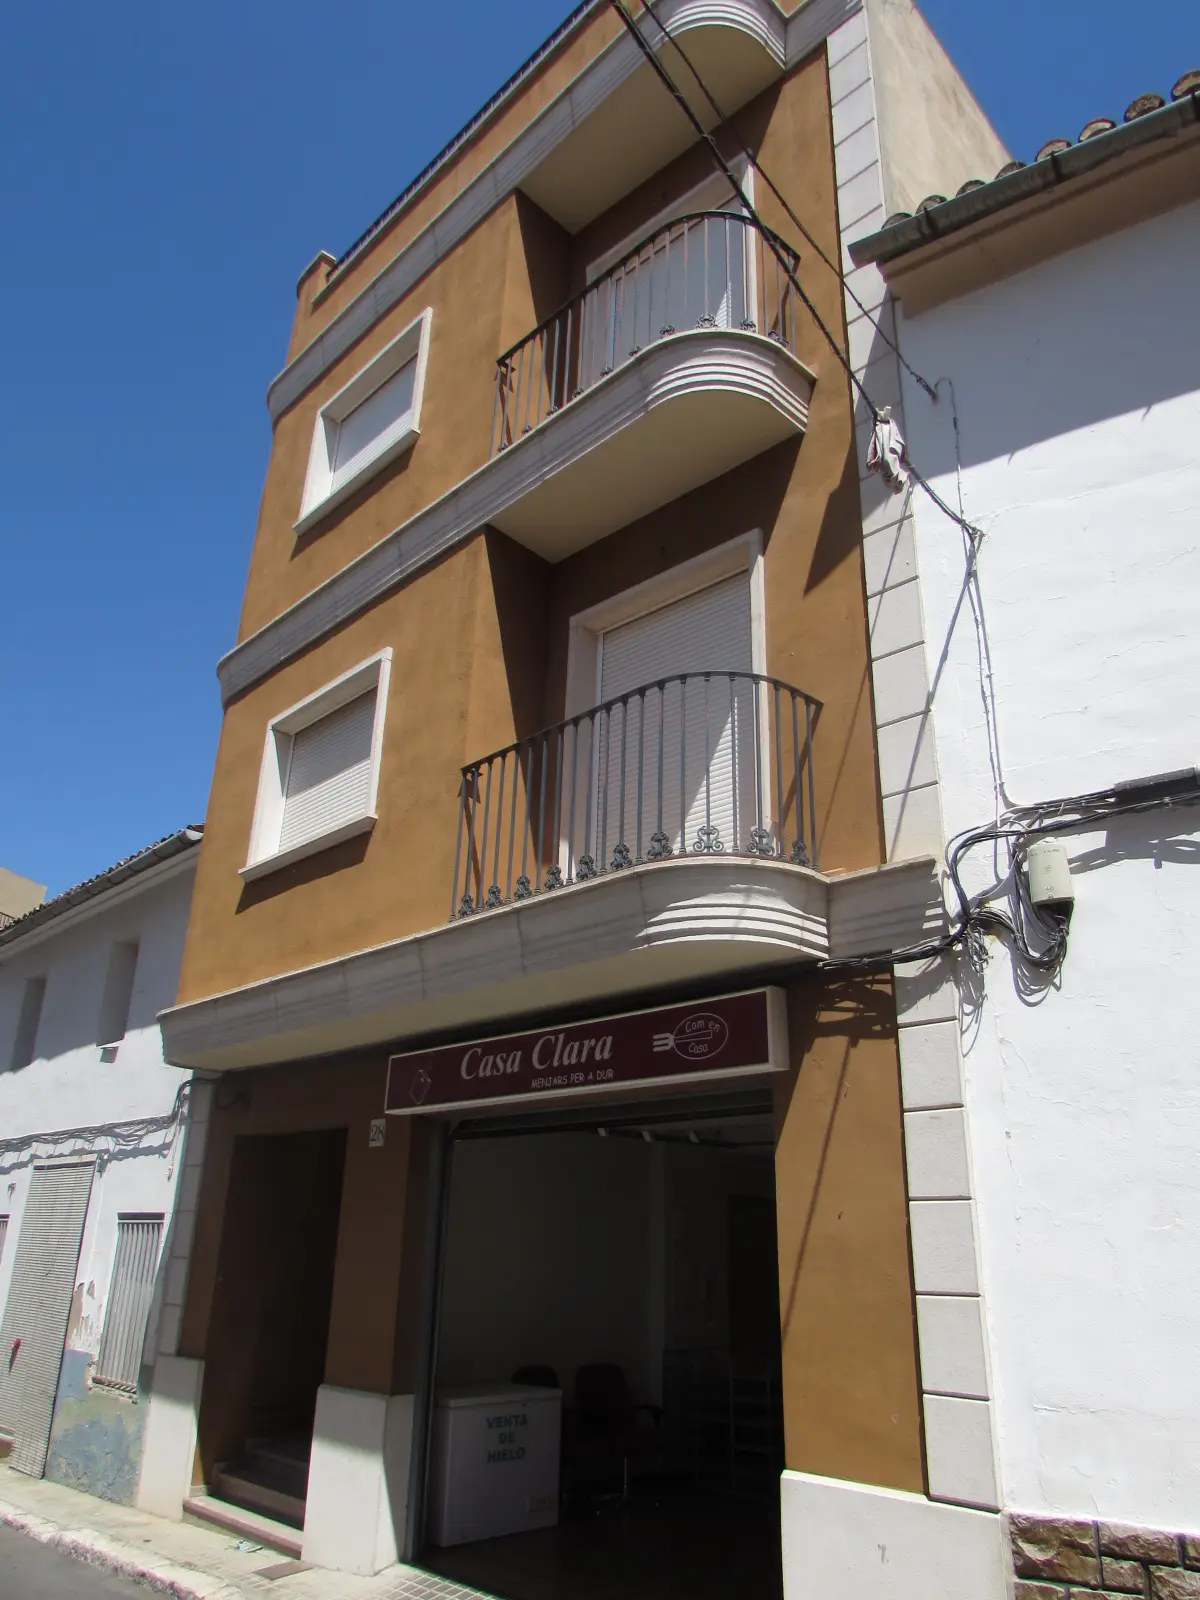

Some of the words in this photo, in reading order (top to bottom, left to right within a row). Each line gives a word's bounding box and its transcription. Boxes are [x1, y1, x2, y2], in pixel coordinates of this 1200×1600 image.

[685, 1020, 705, 1033] Com
[708, 1021, 720, 1032] en
[460, 1048, 522, 1081] Casa
[531, 1032, 613, 1070] Clara
[688, 1042, 709, 1054] Casa
[530, 1075, 568, 1089] MENJARS
[570, 1072, 585, 1084] PER
[588, 1071, 594, 1081] A
[597, 1068, 614, 1081] DUR
[370, 1124, 385, 1142] 28
[486, 1413, 529, 1430] VENTA
[498, 1431, 516, 1444] DE
[487, 1447, 526, 1464] HIELO
